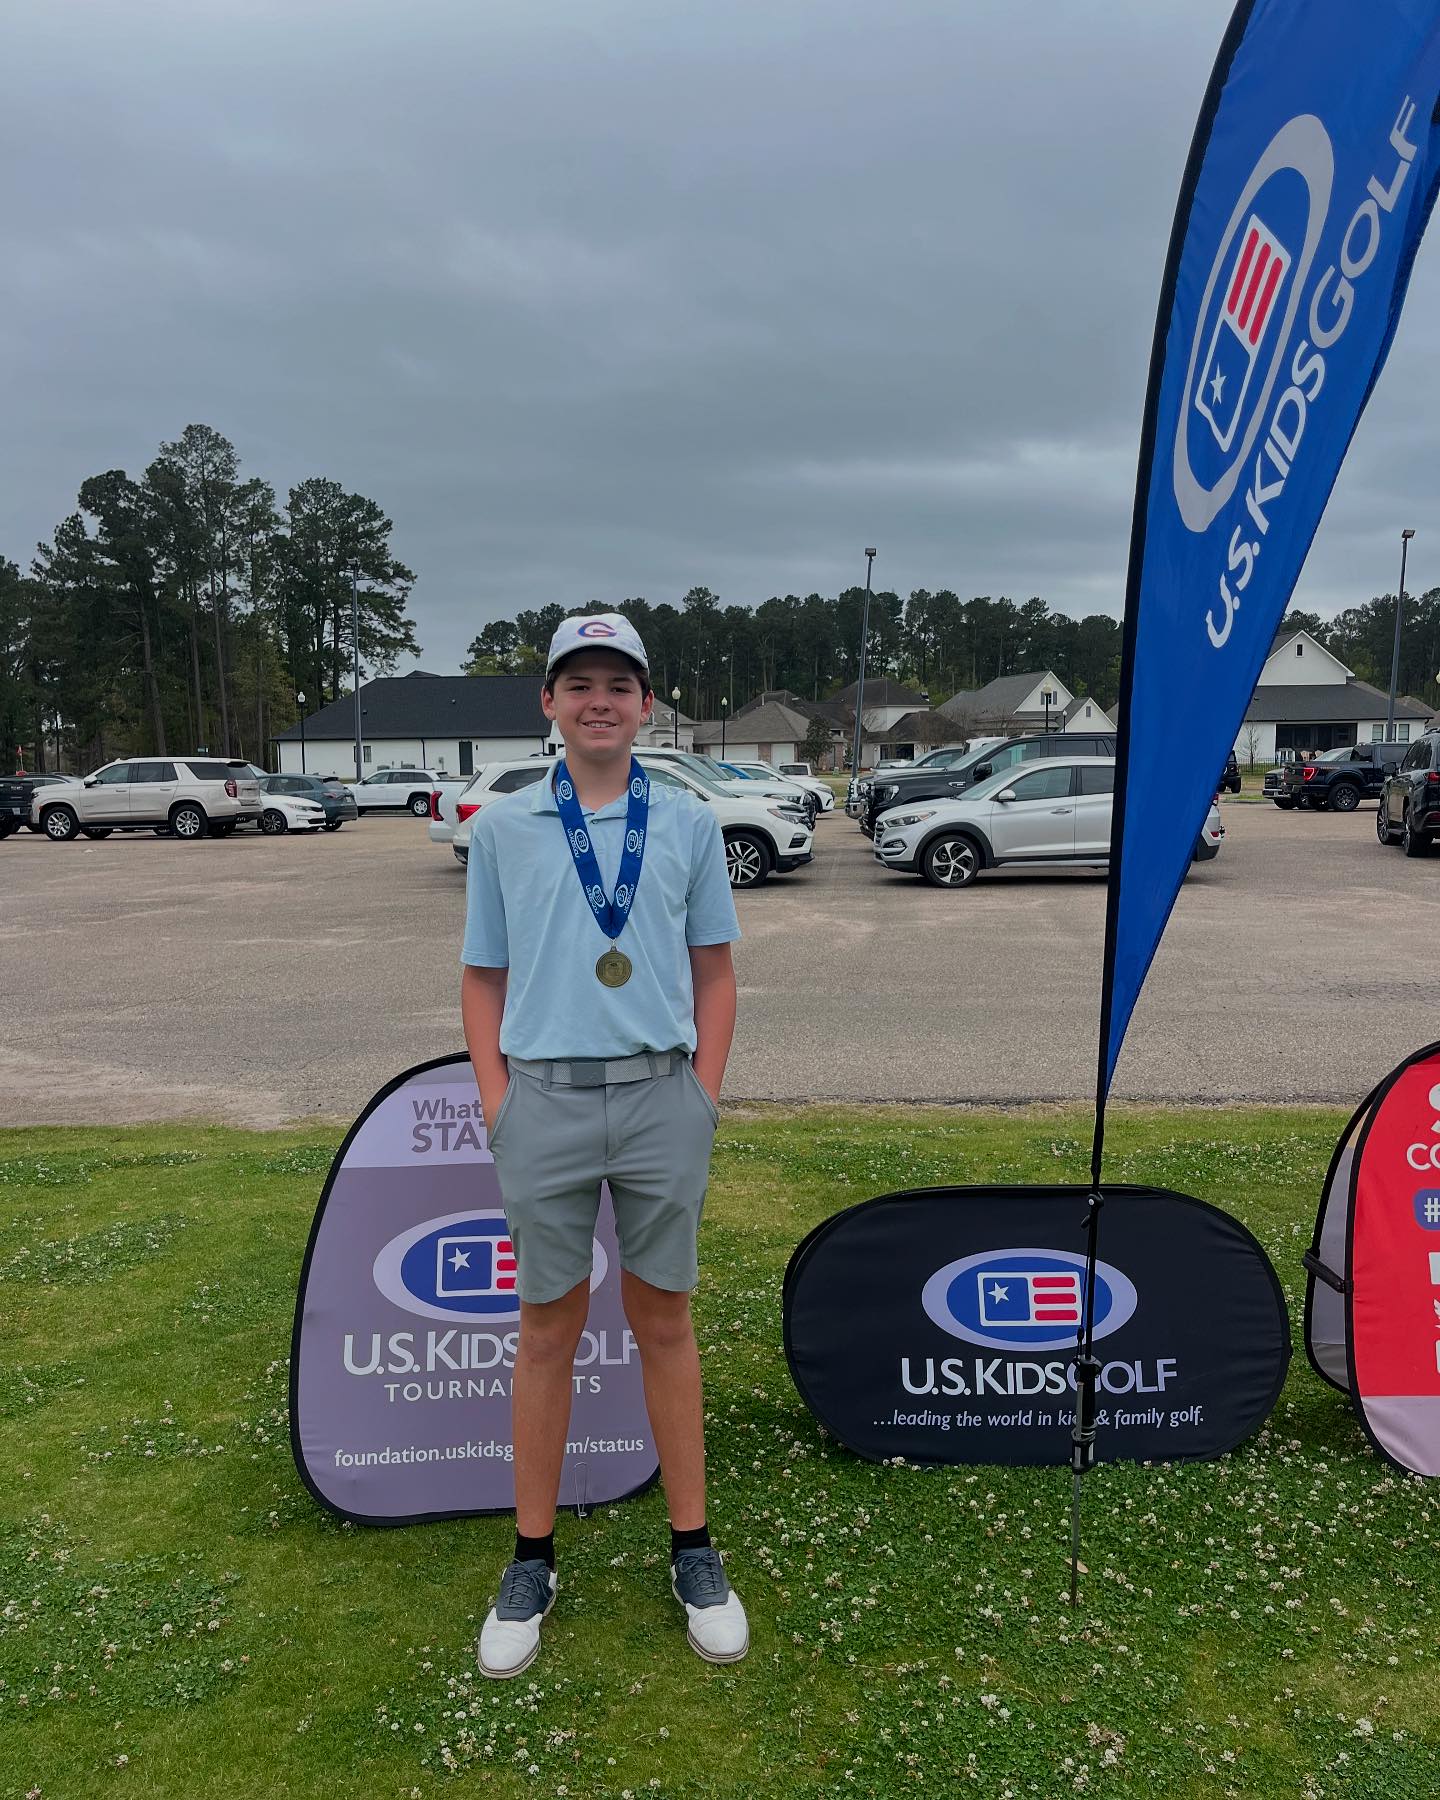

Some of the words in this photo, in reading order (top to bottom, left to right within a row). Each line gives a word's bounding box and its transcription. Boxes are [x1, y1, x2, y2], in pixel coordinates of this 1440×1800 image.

[576, 621, 617, 638] G
[412, 1097, 483, 1121] What
[343, 1329, 639, 1375] U.S.KIDSOLF
[384, 1375, 601, 1402] TOURNATS
[956, 1410, 982, 1427] the
[988, 1410, 1032, 1427] world
[1038, 1410, 1052, 1426] in
[1058, 1409, 1077, 1426] ki
[1096, 1409, 1110, 1426] &
[1114, 1407, 1165, 1429] family
[1170, 1405, 1204, 1427] golf.
[334, 1437, 644, 1467] foundation.uskidsgm/status
